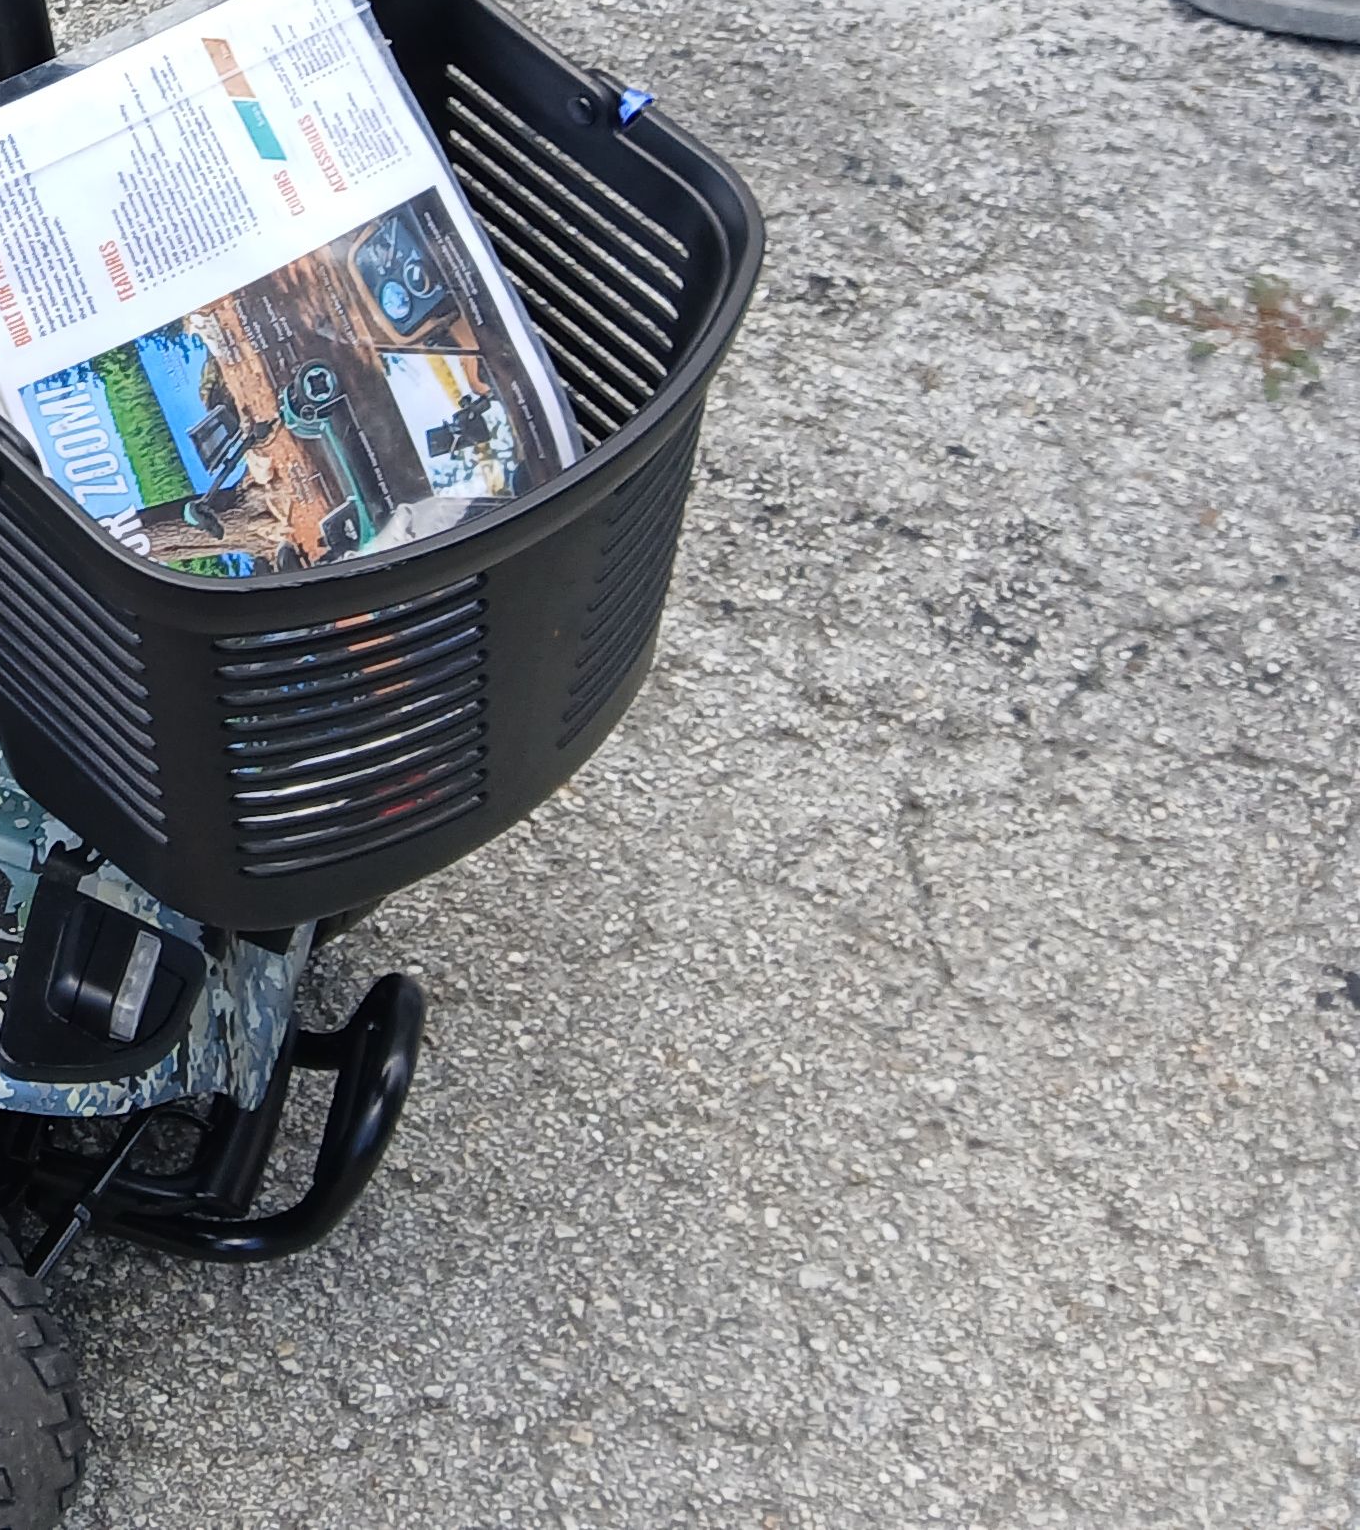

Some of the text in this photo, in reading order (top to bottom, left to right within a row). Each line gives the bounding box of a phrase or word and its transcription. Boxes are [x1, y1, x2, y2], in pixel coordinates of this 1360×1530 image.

[298, 114, 347, 193] ACCESSORIES
[273, 169, 305, 216] COLORS
[99, 240, 136, 302] FEATURES
[3, 311, 32, 348] BUILT
[35, 382, 129, 505] ZOOM!
